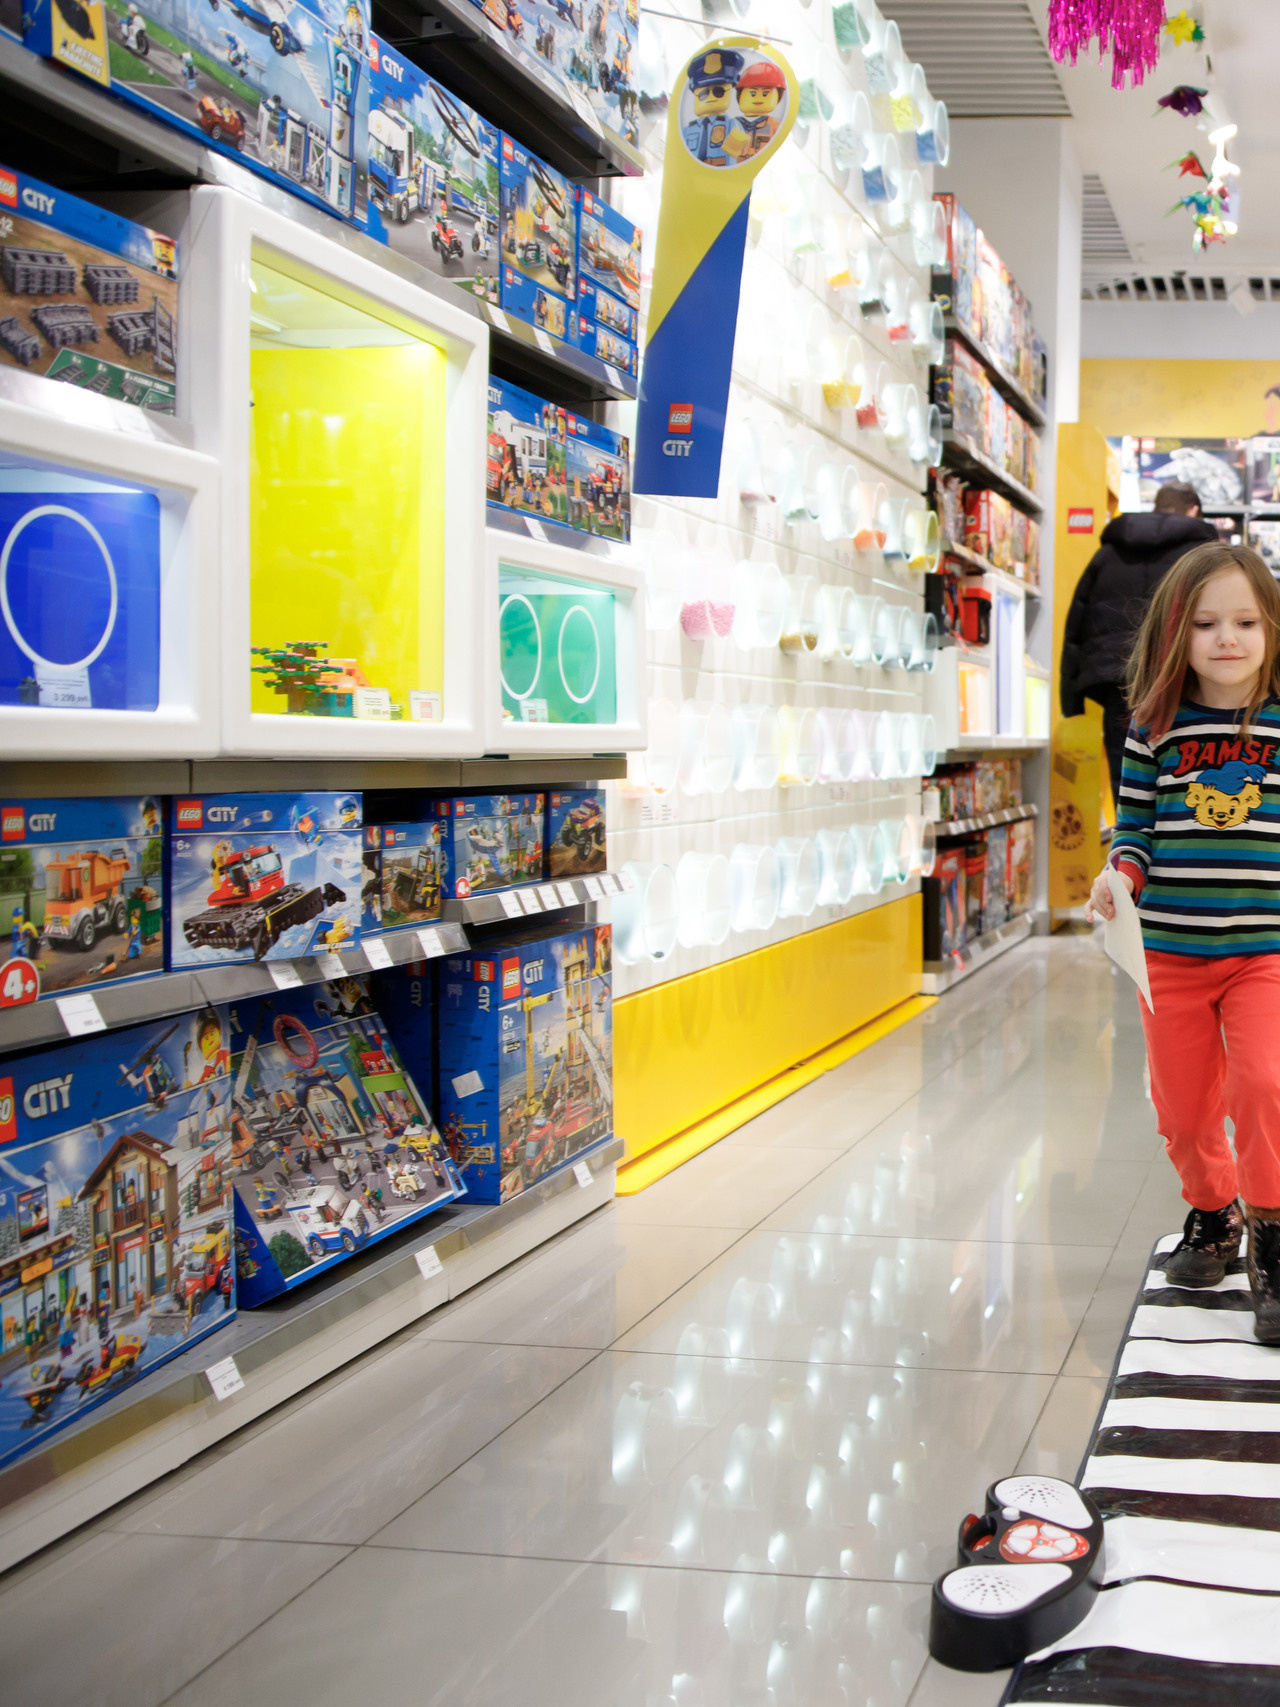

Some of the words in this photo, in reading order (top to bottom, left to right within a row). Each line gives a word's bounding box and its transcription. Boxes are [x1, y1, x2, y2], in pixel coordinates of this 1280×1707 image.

[381, 54, 405, 83] CITY
[22, 187, 56, 216] CITY
[669, 410, 693, 425] LEGO
[662, 438, 695, 457] CITY
[1068, 513, 1094, 528] LEGO
[1173, 740, 1277, 776] BAMSE
[3, 816, 24, 831] LEGO
[28, 813, 57, 832] CITY
[179, 807, 202, 822] LEGO
[207, 806, 239, 823] CITY
[176, 839, 191, 851] 6+
[479, 962, 489, 981] LEGO
[503, 968, 521, 989] LEGO
[523, 958, 545, 985] CITY
[3, 968, 36, 1000] 4+
[410, 980, 422, 1007] CITY
[478, 985, 491, 1013] CITY
[502, 1015, 514, 1030] 6+
[22, 1072, 74, 1120] CITY
